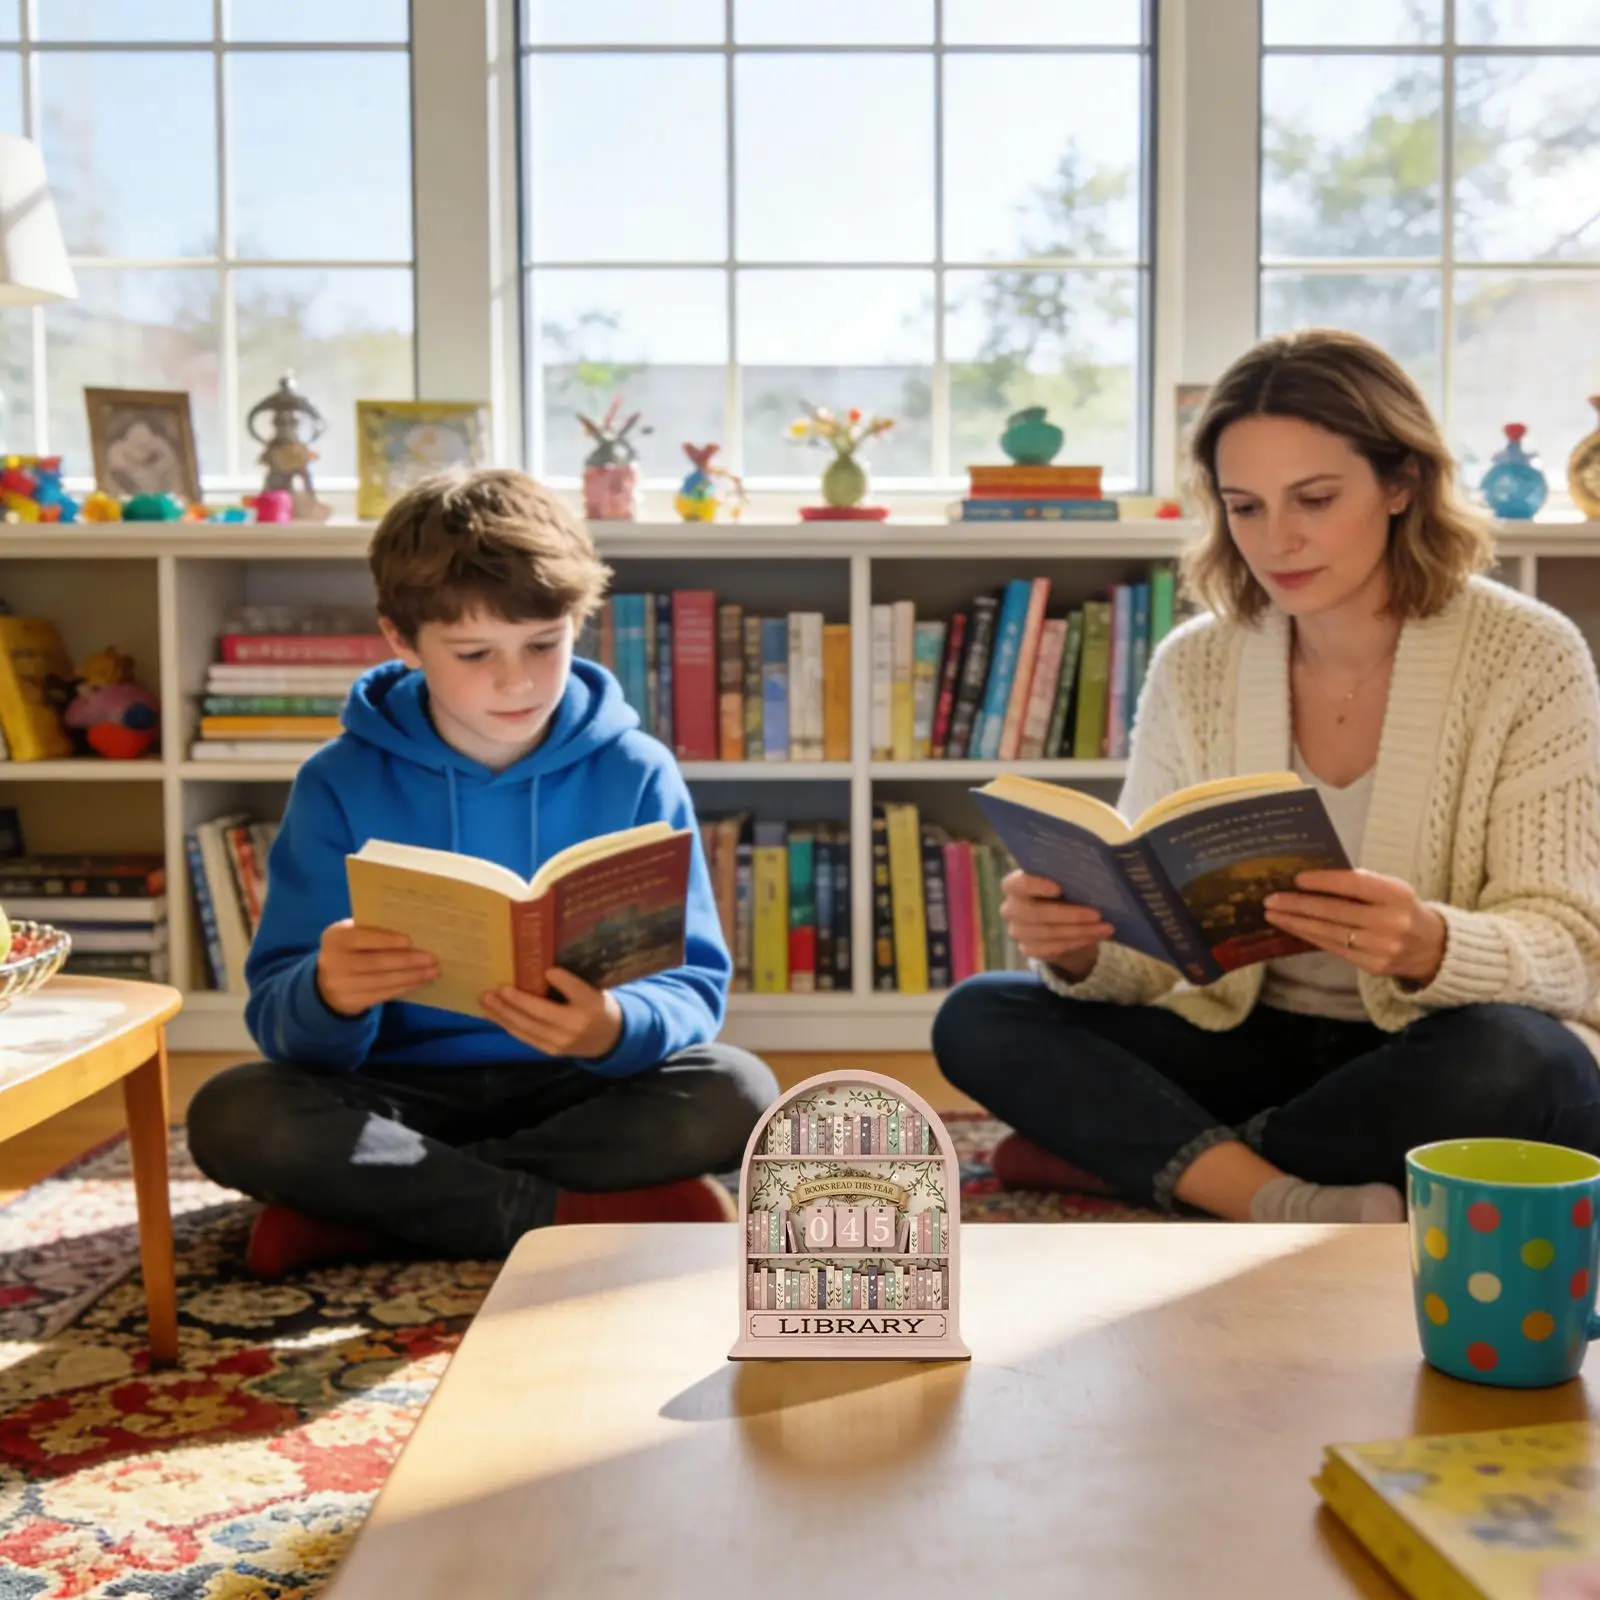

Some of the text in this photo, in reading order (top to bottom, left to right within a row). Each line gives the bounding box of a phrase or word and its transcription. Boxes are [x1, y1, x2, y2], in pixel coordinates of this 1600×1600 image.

[804, 1181, 894, 1195] BOOKS READ THIS YEAR
[778, 1318, 925, 1334] LIBRARY
